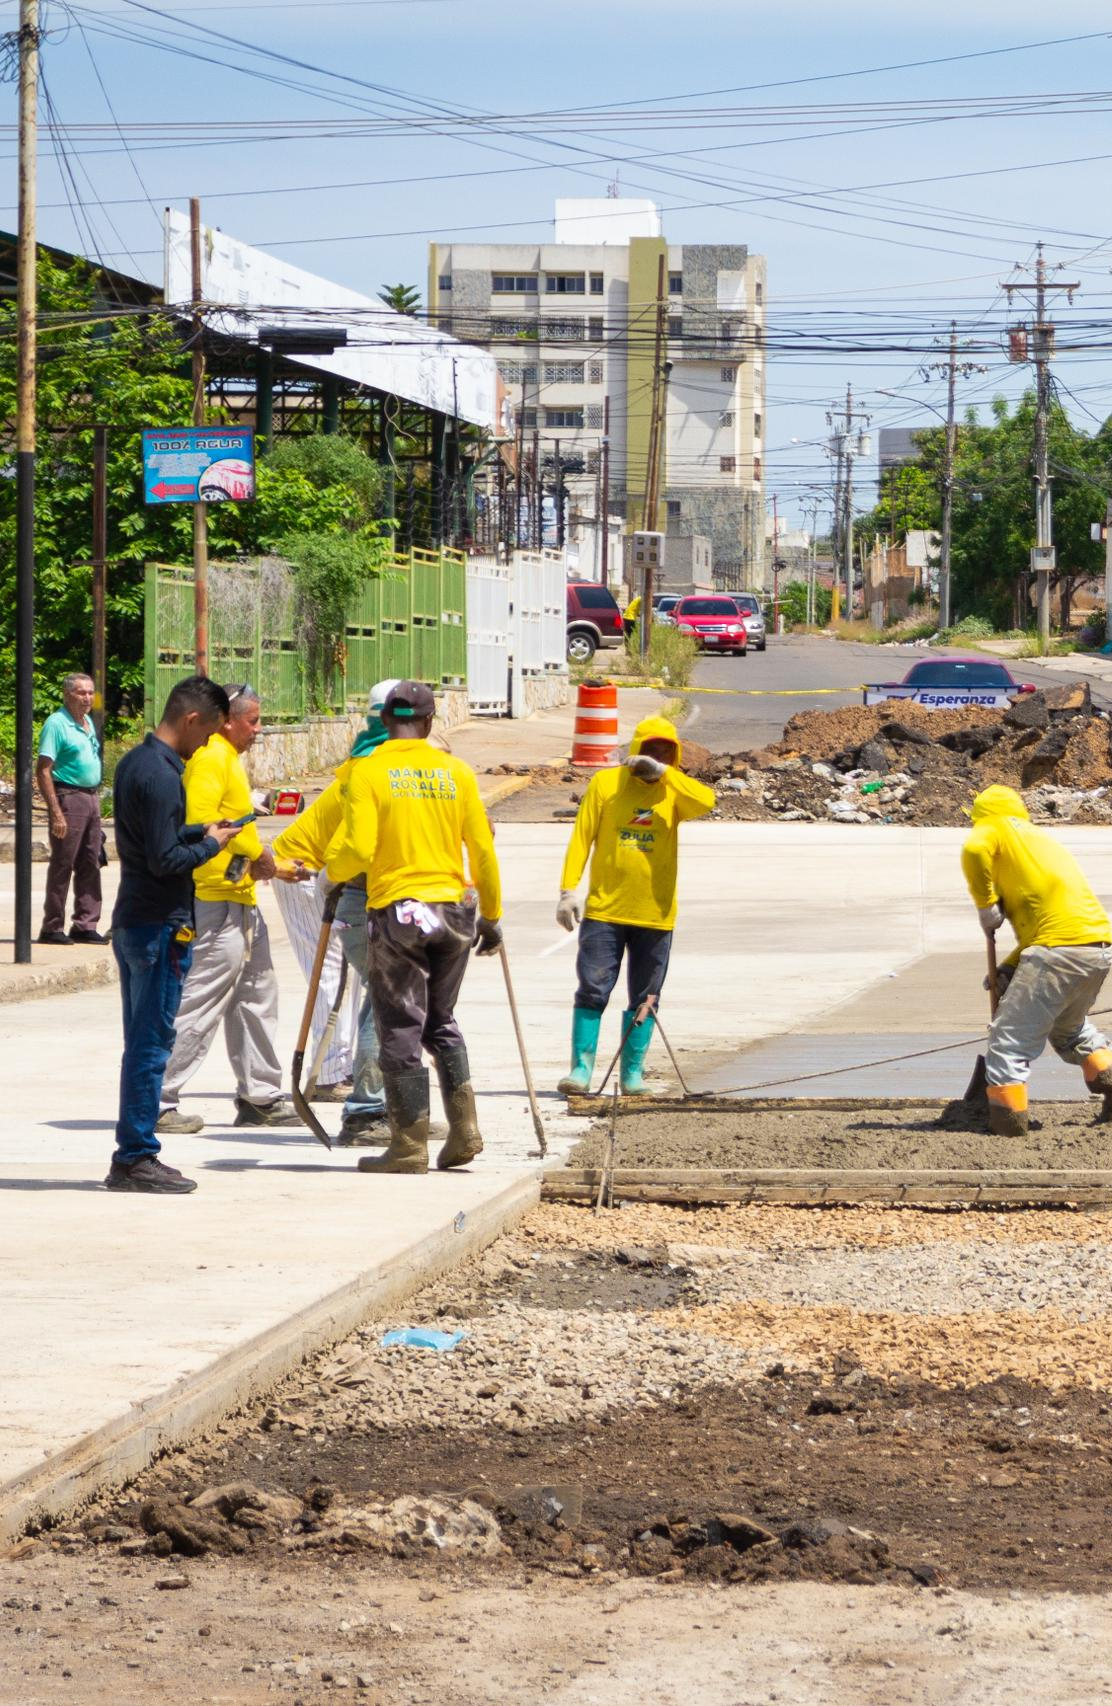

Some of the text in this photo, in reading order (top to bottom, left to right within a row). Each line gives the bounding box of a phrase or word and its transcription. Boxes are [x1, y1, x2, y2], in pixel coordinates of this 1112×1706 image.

[152, 439, 242, 451] 100% AGUA
[919, 693, 996, 706] Esperanza
[389, 769, 454, 780] MANUEL
[391, 780, 456, 792] ROSALES
